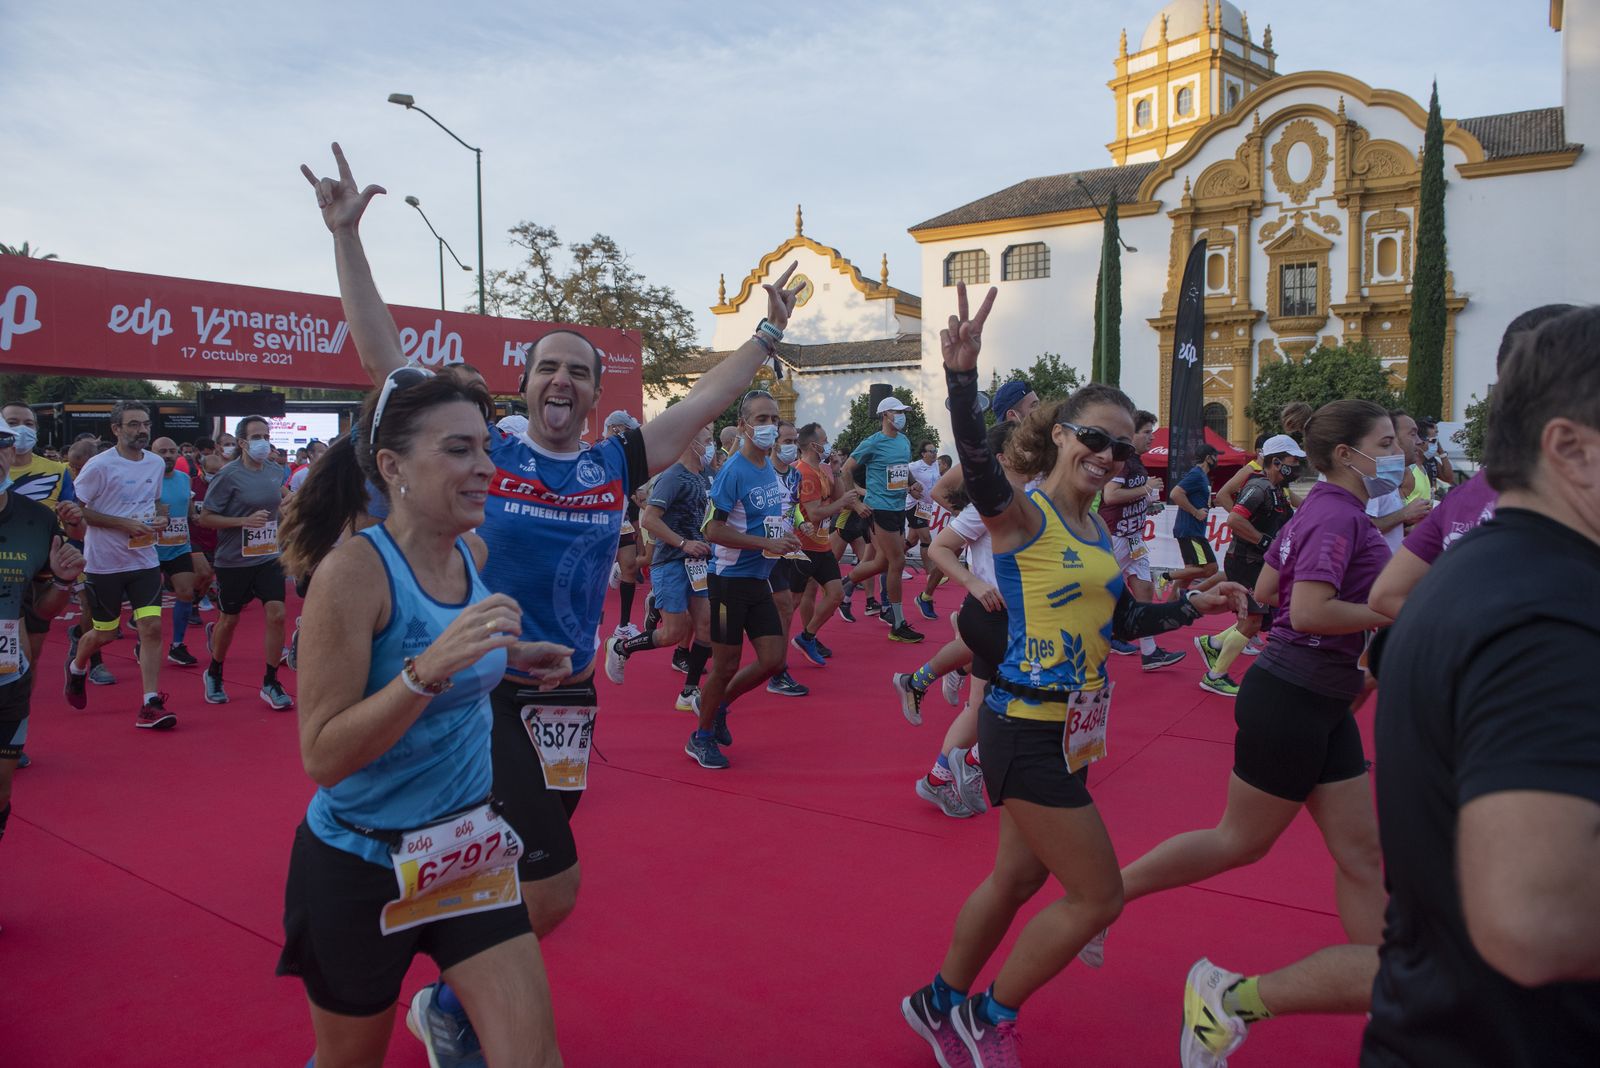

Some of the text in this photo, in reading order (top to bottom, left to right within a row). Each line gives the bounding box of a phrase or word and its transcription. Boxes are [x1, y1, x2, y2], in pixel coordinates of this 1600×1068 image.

[107, 298, 173, 345] edp
[224, 308, 329, 334] maratón
[253, 329, 336, 354] sevilla
[1178, 338, 1197, 367] edp
[181, 347, 293, 365] 17 octubre 2021
[504, 501, 520, 514] LA
[521, 504, 567, 521] PUEBLA
[569, 512, 590, 524] DEL
[408, 834, 433, 854] edp
[455, 821, 475, 838] edp
[416, 831, 502, 892] 6797
